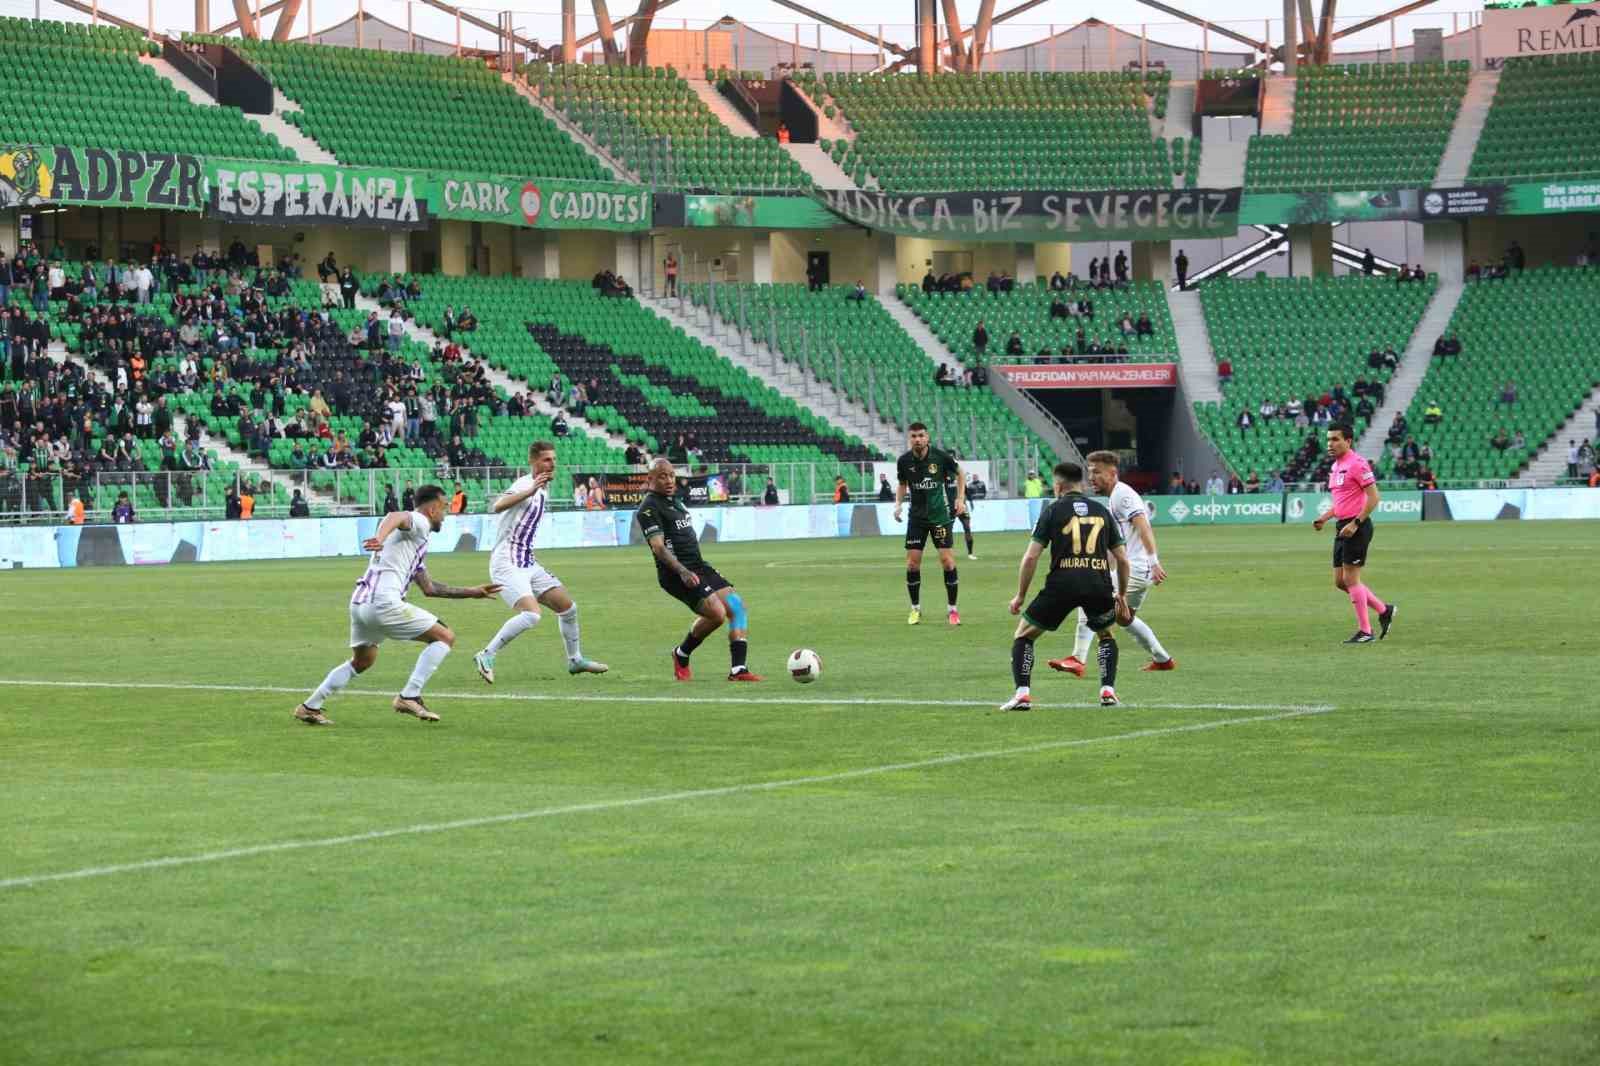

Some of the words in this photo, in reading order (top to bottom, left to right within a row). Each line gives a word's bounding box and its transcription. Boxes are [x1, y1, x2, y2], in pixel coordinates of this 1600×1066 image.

[51, 145, 202, 206] ADPZR
[216, 169, 420, 222] ESPERANZA
[1193, 504, 1232, 517] SKRY
[1234, 502, 1282, 516] TOKEN
[1377, 500, 1422, 513] TOKEN
[1062, 516, 1105, 555] 17
[1060, 558, 1089, 569] MURAT
